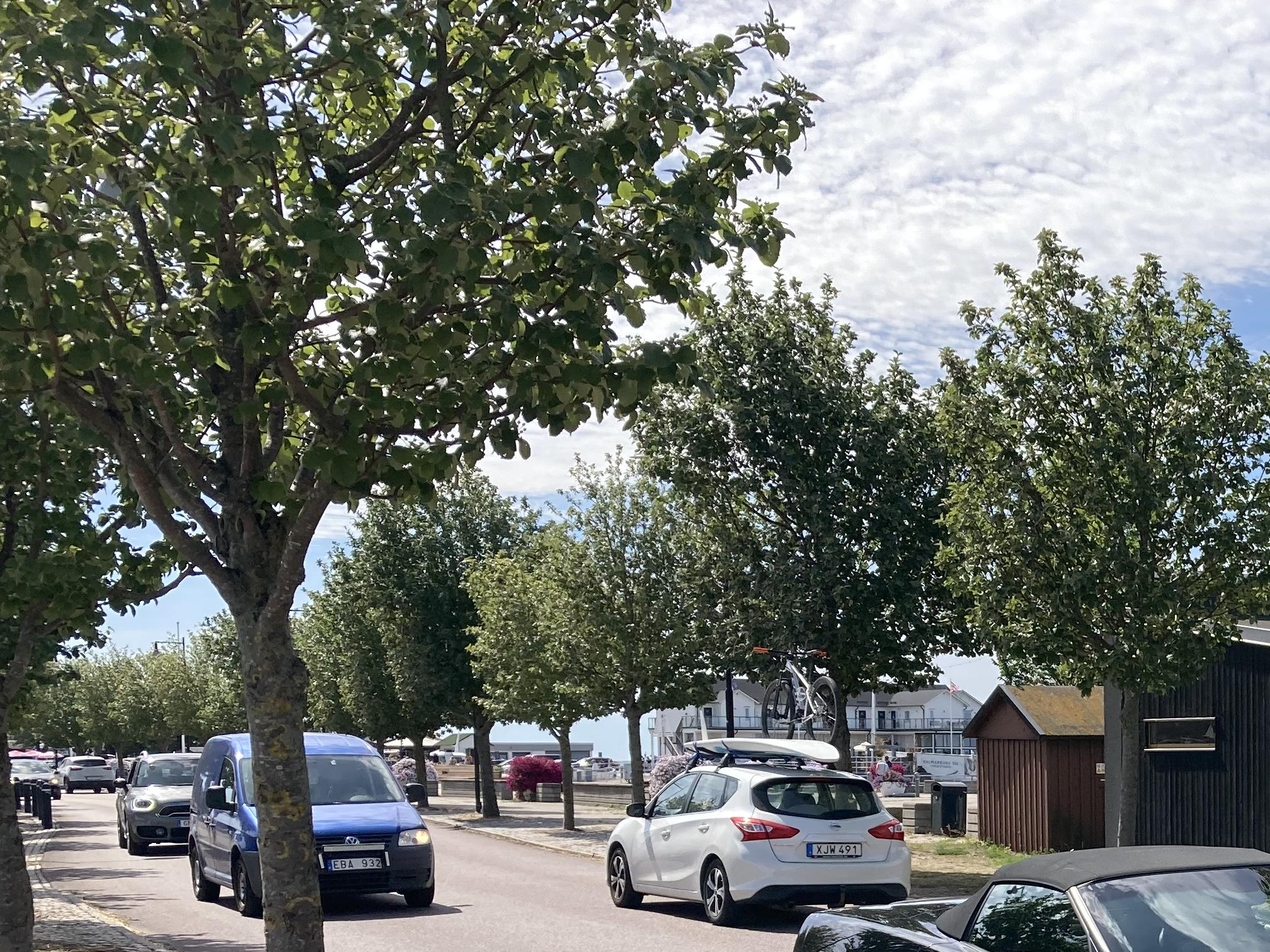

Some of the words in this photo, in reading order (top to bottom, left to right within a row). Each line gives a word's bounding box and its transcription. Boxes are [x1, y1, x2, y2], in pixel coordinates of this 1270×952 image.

[816, 845, 837, 855] XJW
[838, 845, 857, 855] 491
[333, 859, 354, 870] EBA
[361, 858, 381, 868] 932
